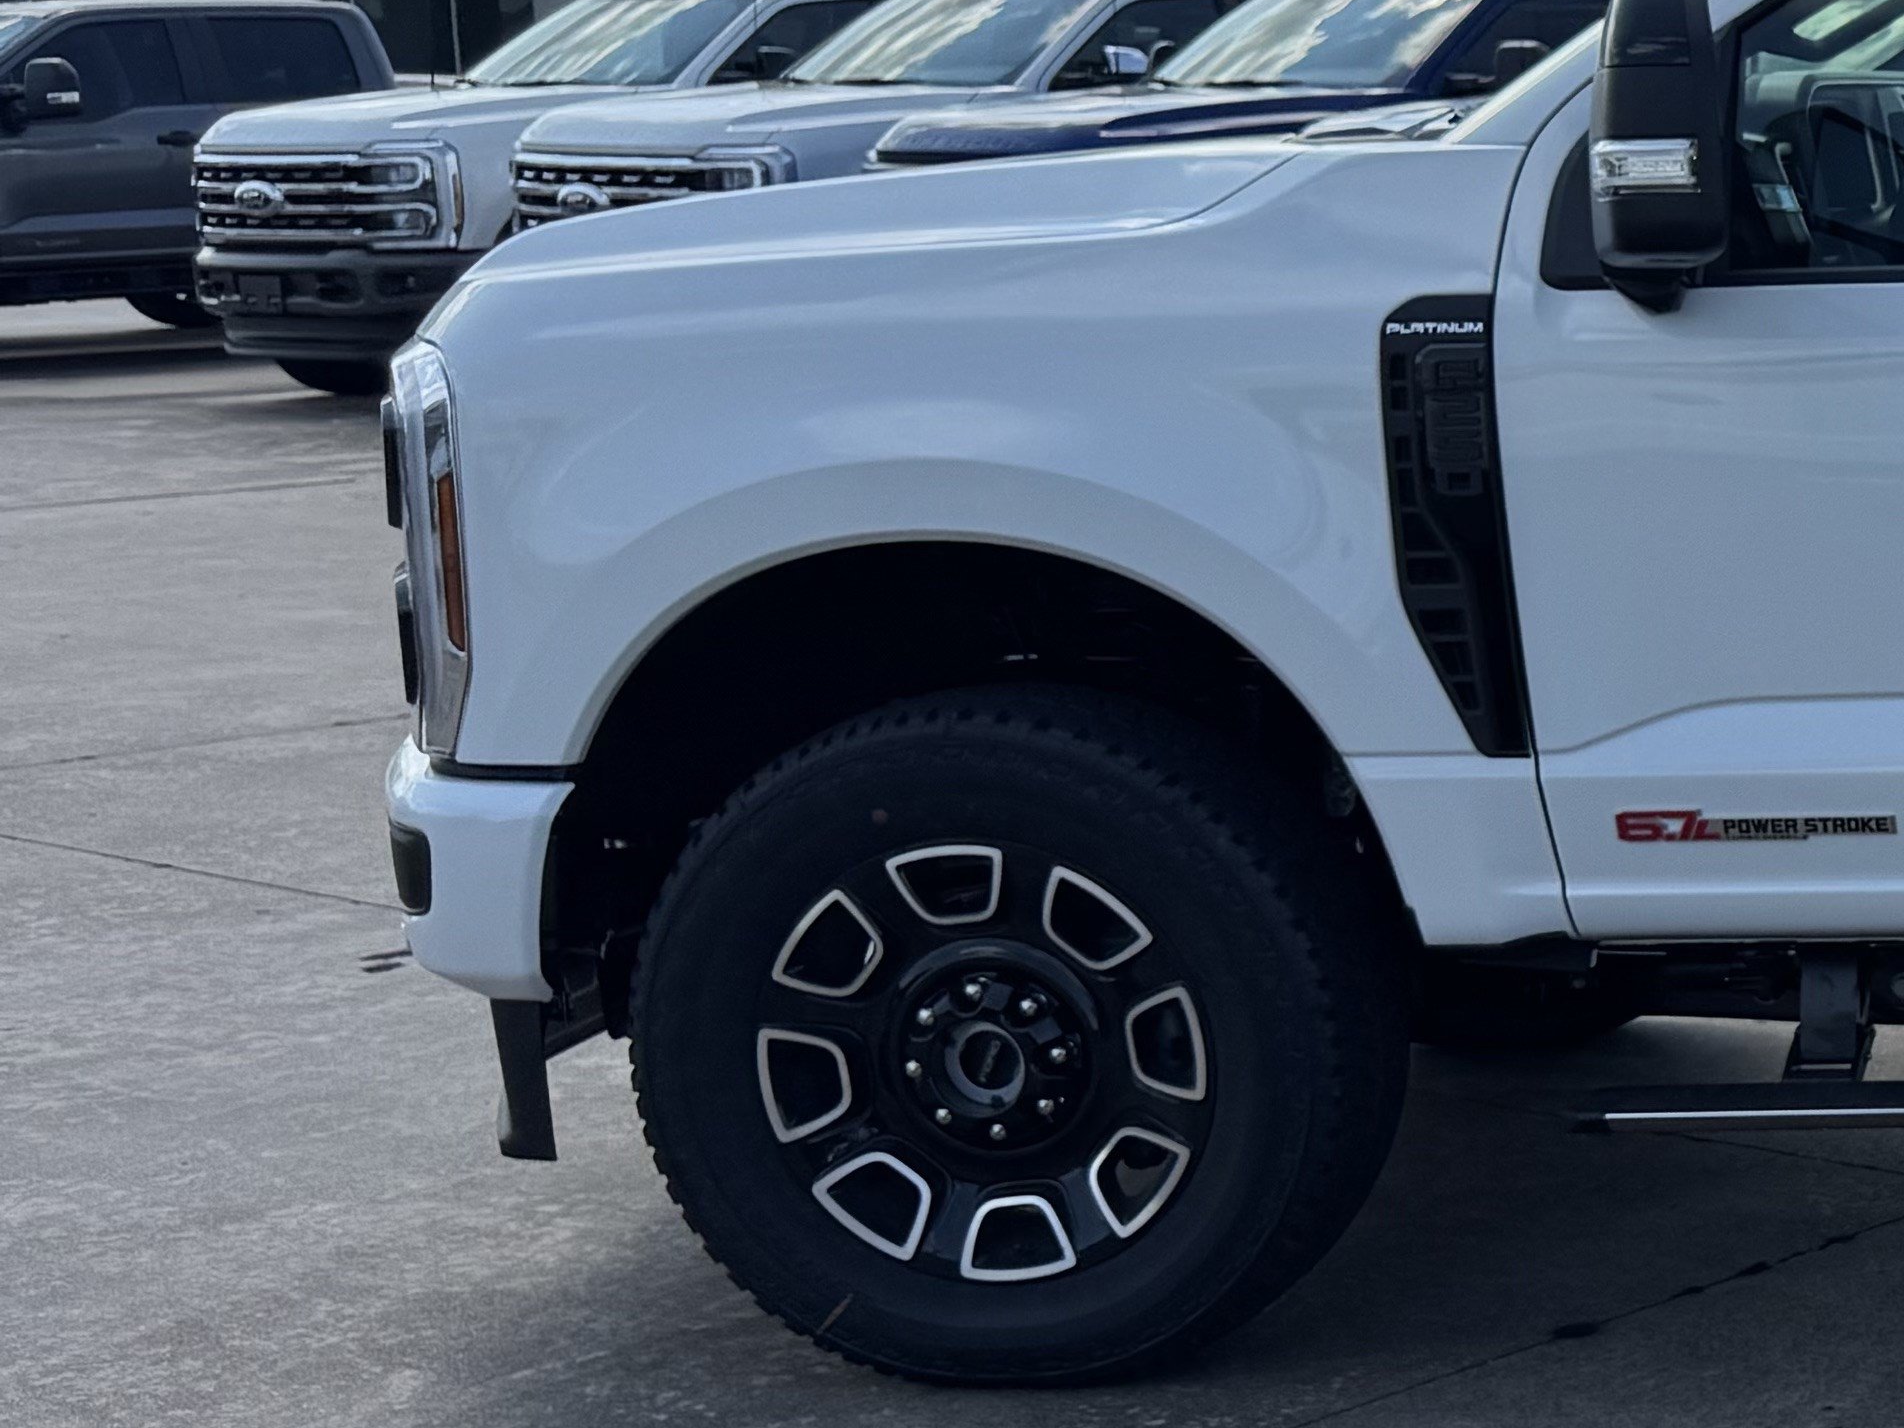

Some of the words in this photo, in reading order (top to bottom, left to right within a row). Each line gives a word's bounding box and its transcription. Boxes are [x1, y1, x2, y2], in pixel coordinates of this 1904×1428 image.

[1385, 321, 1484, 335] PLATINUM
[1722, 818, 1799, 835] POWER
[1803, 816, 1890, 834] STROKE
